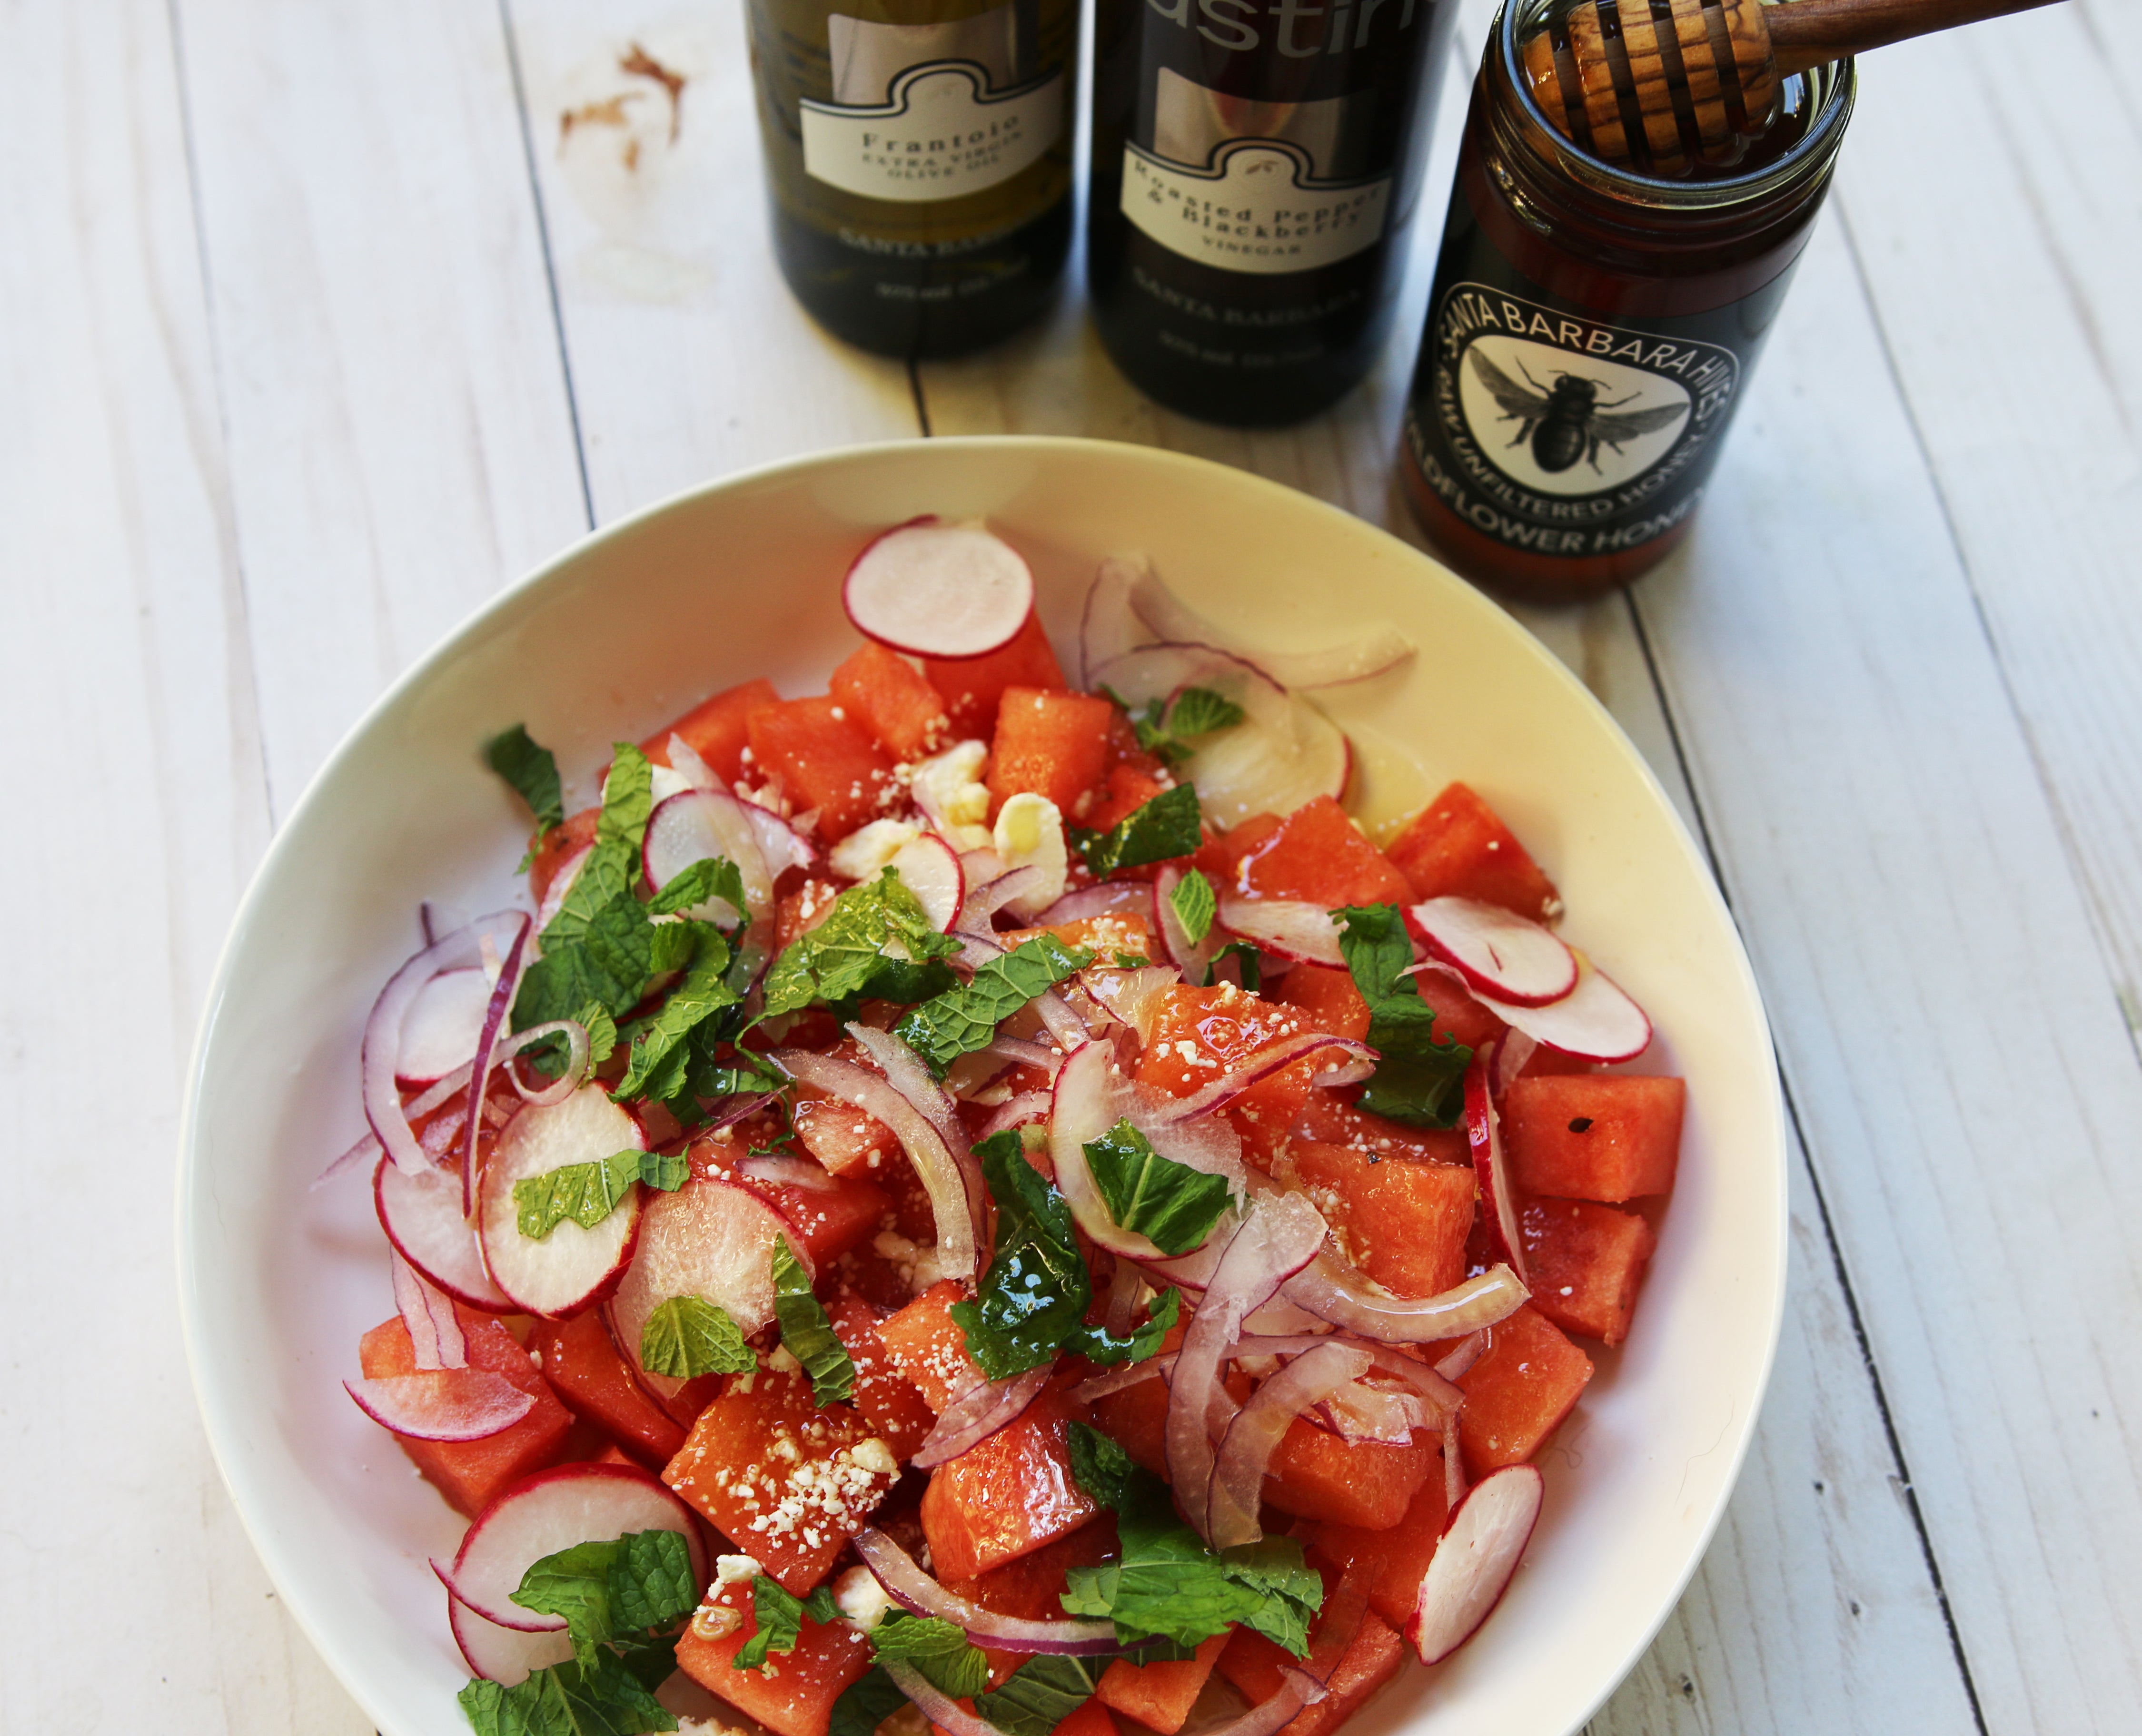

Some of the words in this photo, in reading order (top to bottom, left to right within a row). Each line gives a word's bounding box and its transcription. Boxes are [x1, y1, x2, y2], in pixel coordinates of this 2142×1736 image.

[1135, 162, 1252, 222] Roasted
[1274, 186, 1381, 222] Pepper
[1183, 206, 1360, 238] Blackberry
[1203, 236, 1302, 256] VINEGAR
[1439, 293, 1501, 360] SANTA
[1501, 300, 1698, 375] BARBARA
[1686, 355, 1731, 421] HIVES
[1408, 419, 1586, 552] DFLOWER
[1453, 436, 1614, 519] UNFILTERED
